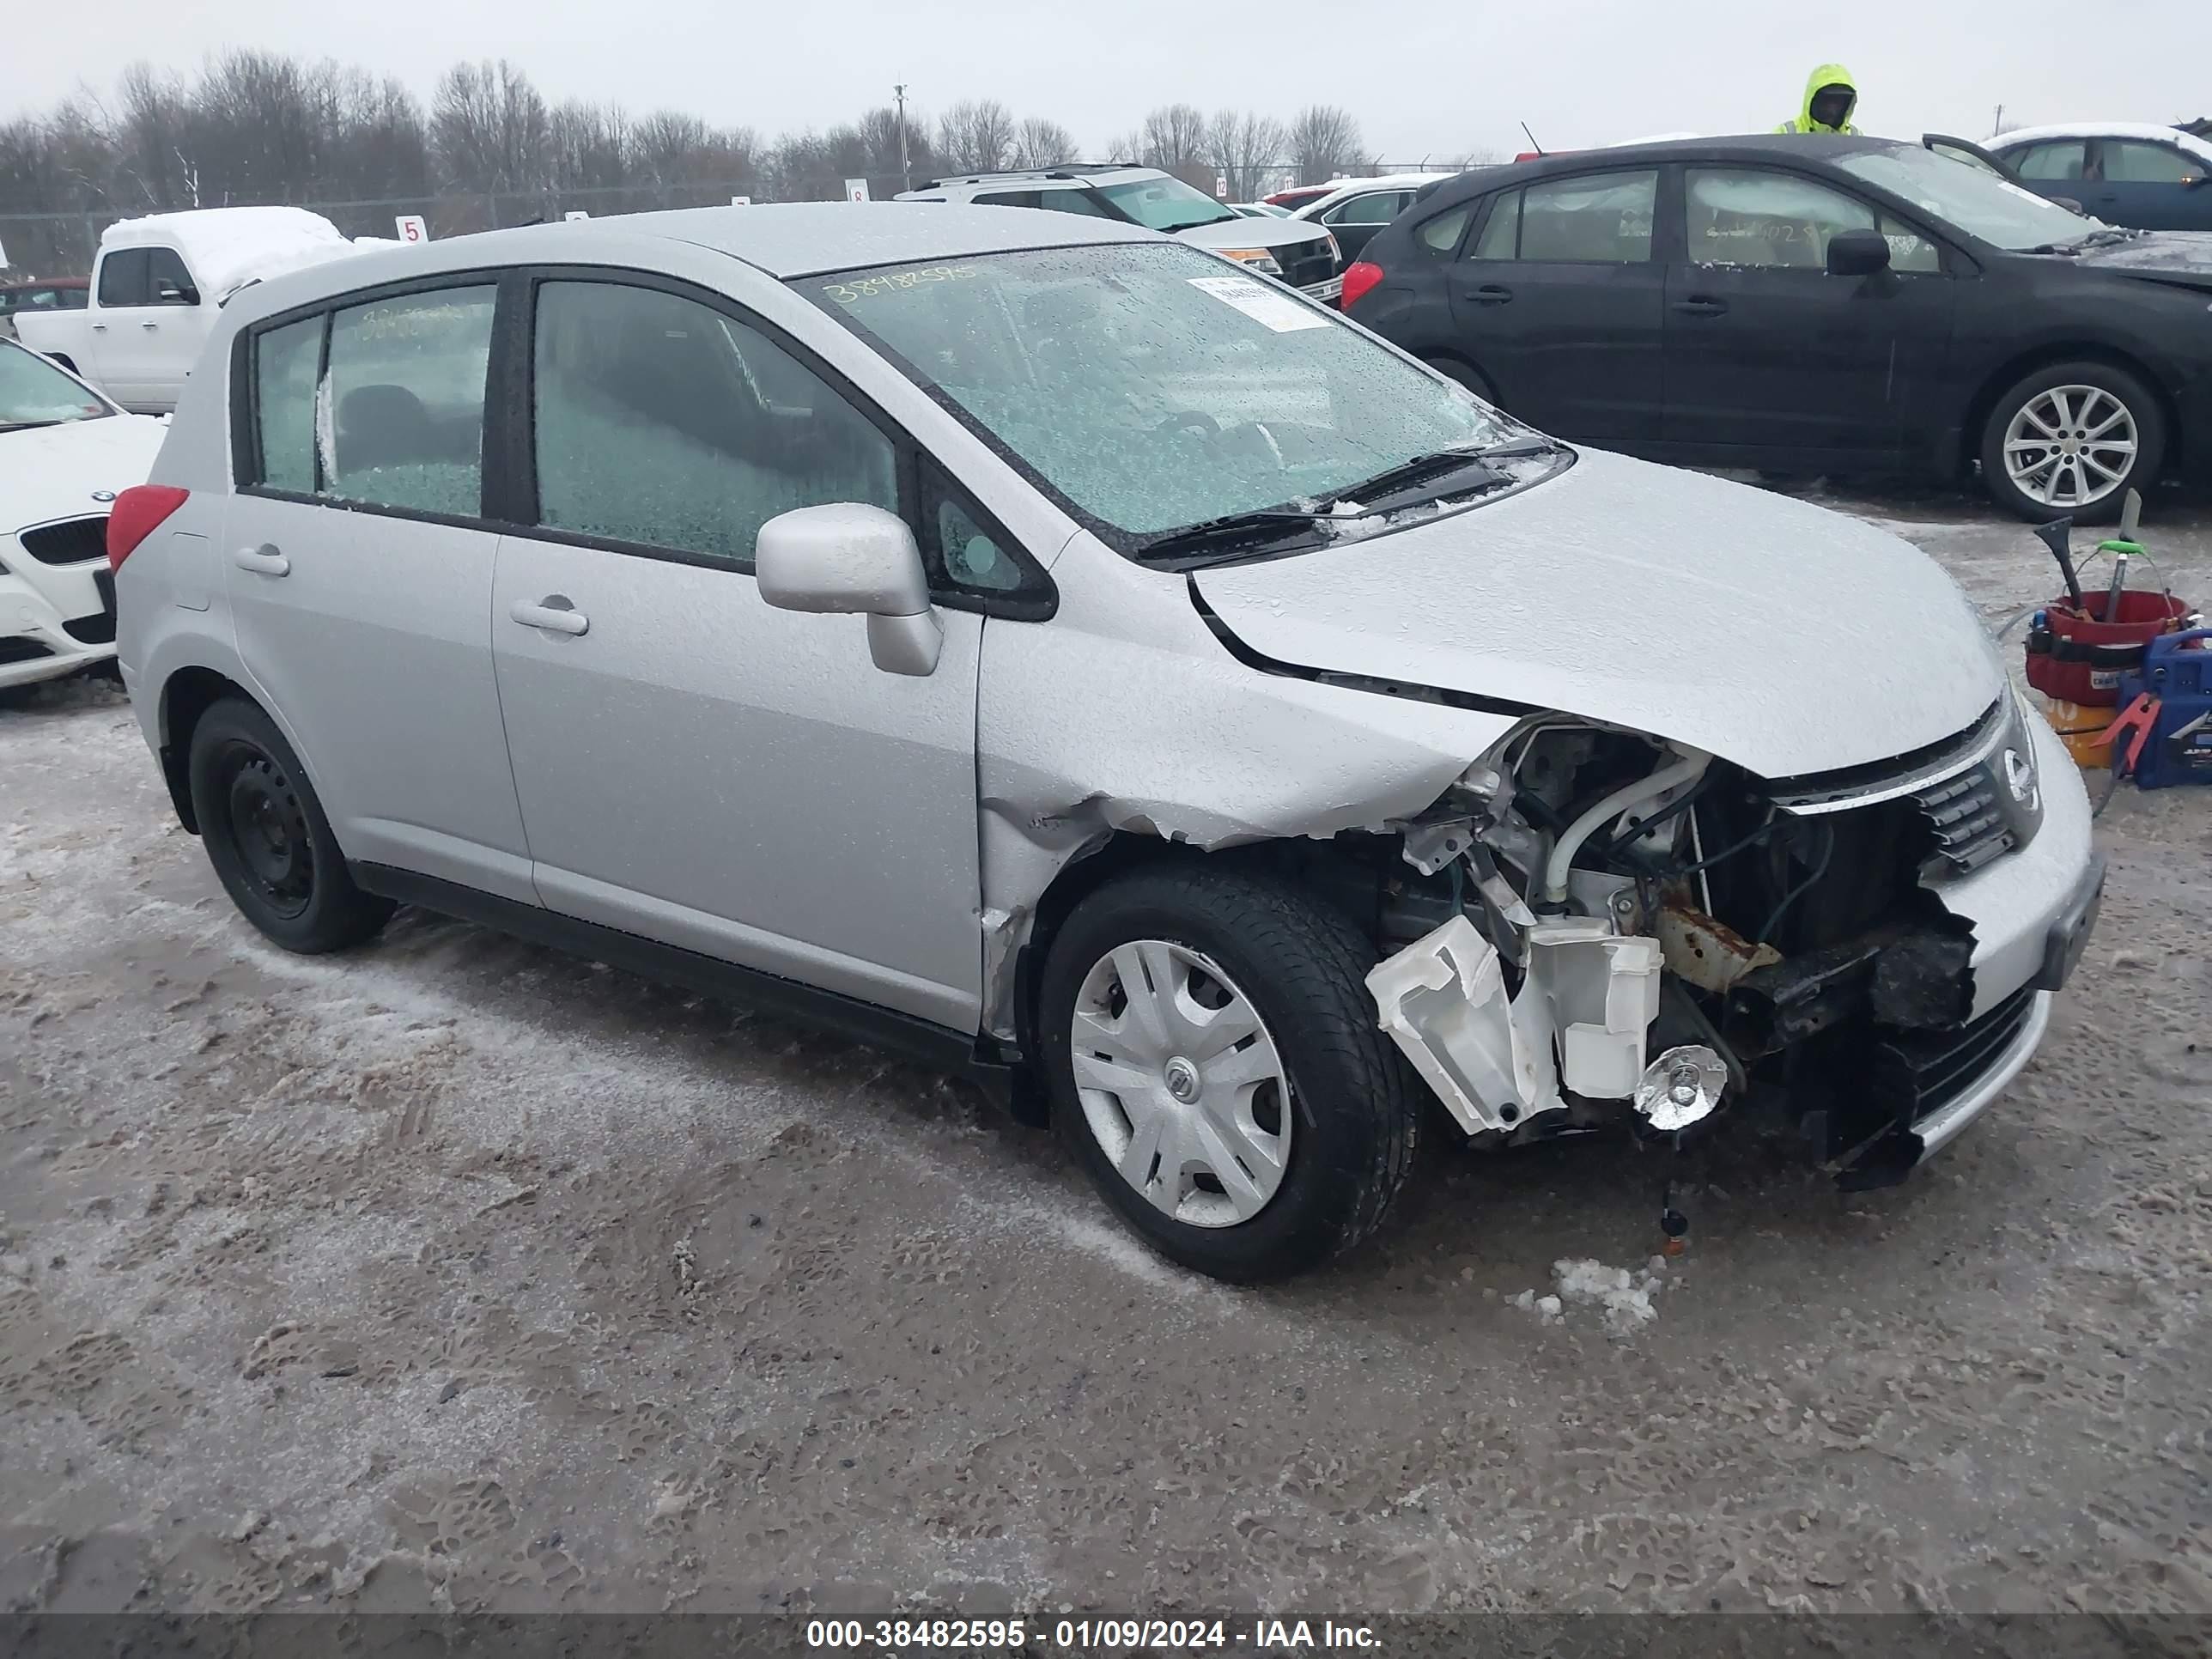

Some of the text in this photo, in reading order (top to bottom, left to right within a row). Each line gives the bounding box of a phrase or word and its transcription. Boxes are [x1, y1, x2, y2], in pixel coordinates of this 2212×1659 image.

[1217, 179, 1226, 193] 12
[404, 222, 419, 241] 5
[822, 266, 976, 303] 38482595
